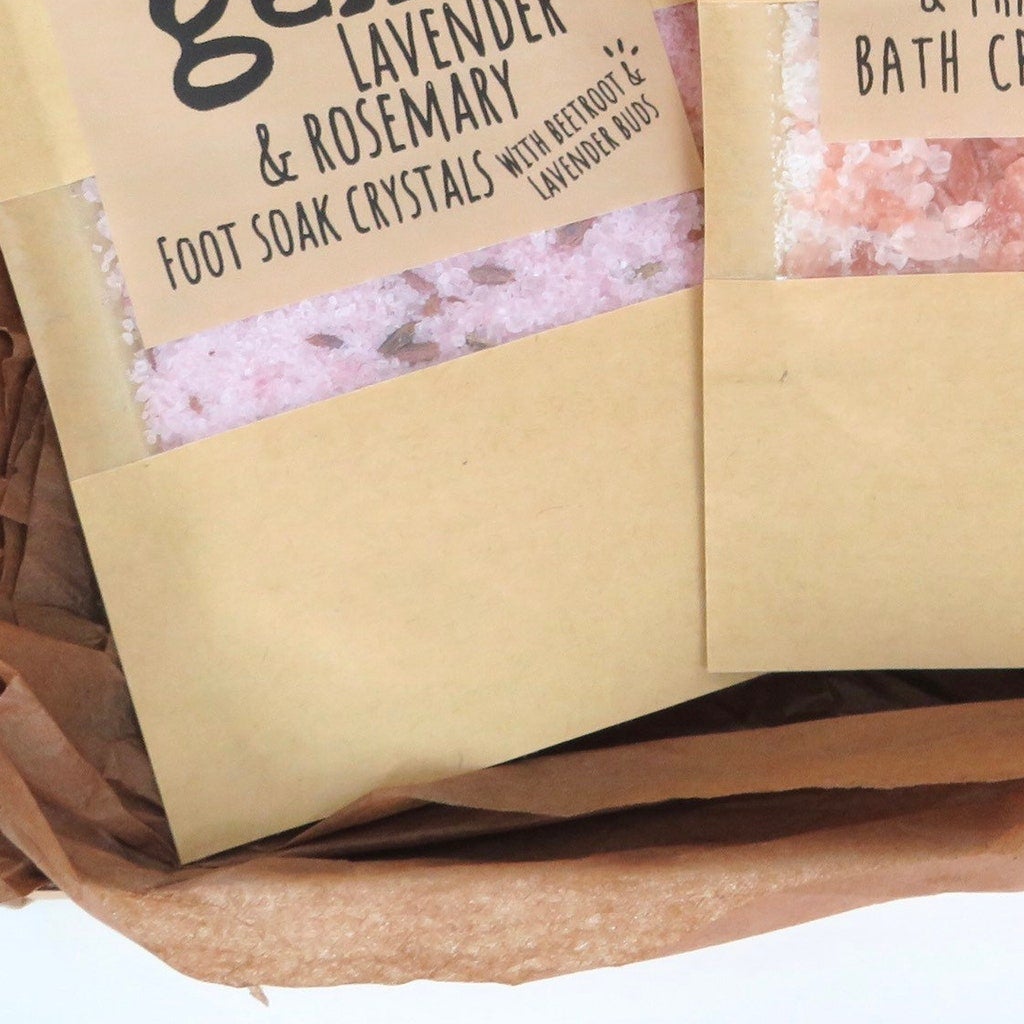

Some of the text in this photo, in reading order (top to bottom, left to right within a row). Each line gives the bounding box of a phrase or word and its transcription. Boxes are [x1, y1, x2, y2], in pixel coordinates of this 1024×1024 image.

[254, 57, 520, 189] & ROSEMARY
[493, 59, 648, 180] WITH BEETROOT &
[854, 28, 960, 97] BATH
[526, 92, 661, 202] LAVENDER BUDS
[155, 148, 496, 292] FOOT SOAK CRYSTALS
